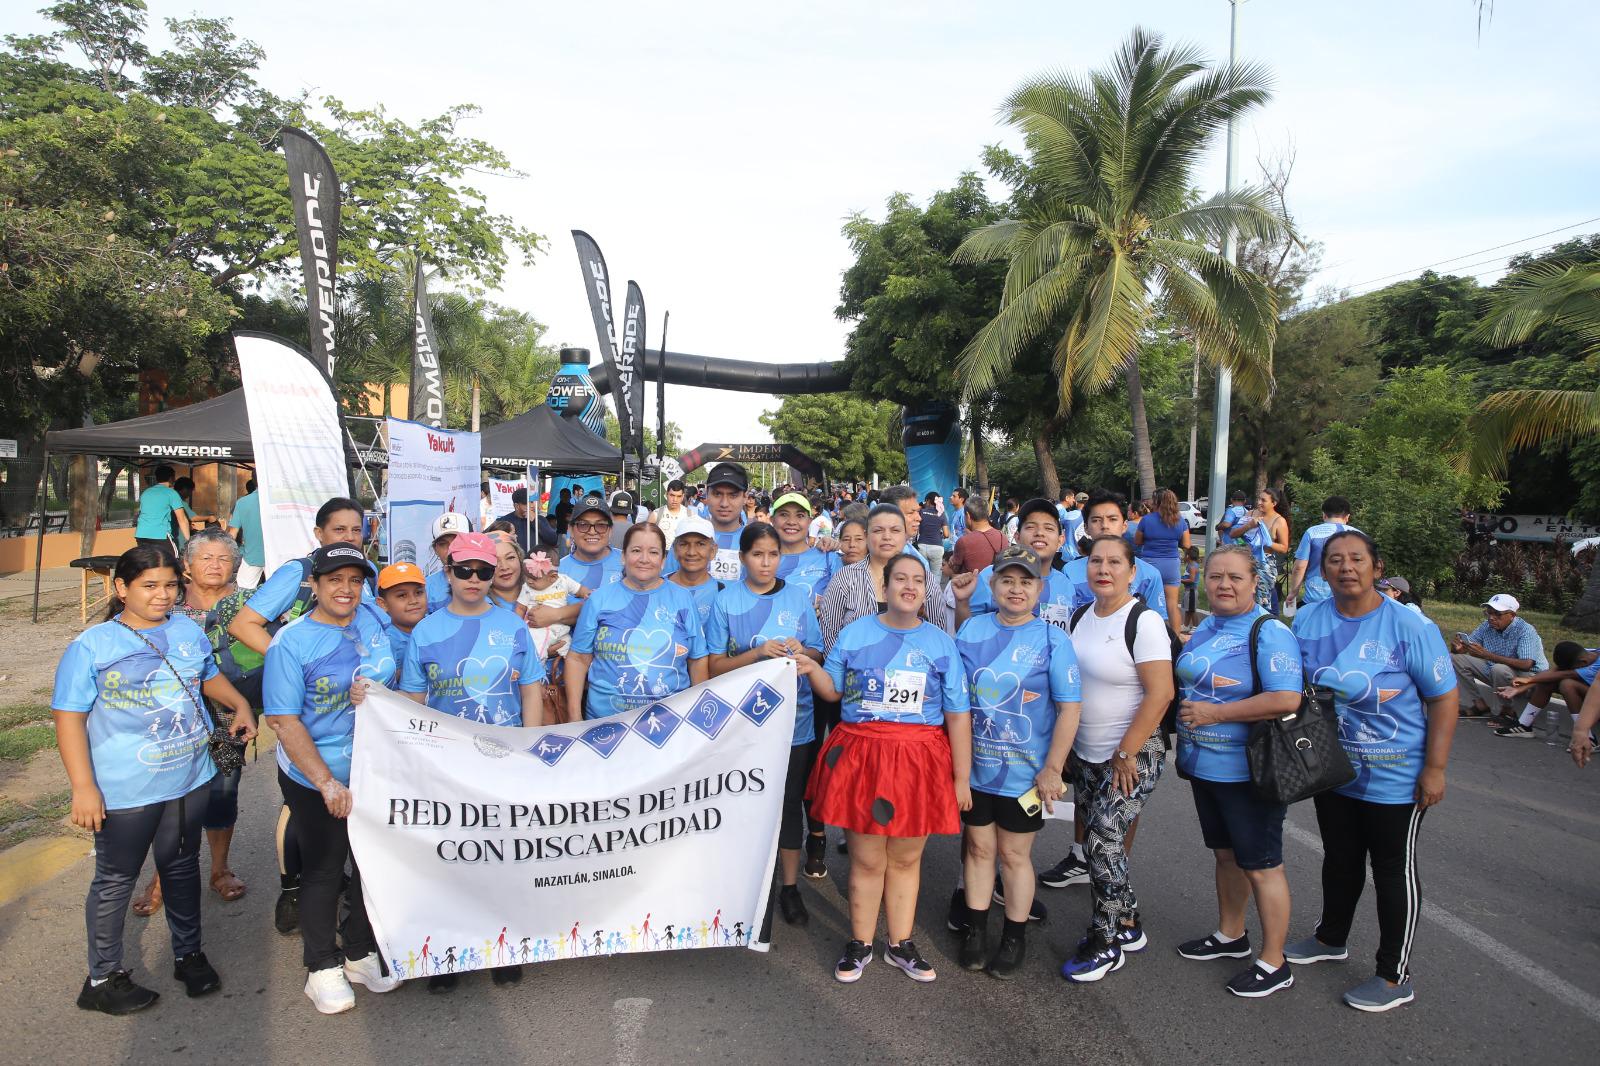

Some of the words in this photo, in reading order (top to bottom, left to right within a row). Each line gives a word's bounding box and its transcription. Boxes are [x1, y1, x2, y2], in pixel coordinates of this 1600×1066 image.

[304, 172, 335, 379] OWERADE
[547, 385, 594, 397] POWER
[427, 432, 455, 453] Yakult
[139, 445, 232, 458] POWERADE
[715, 561, 738, 574] 295
[104, 671, 121, 689] 8
[428, 663, 439, 680] 8
[315, 676, 330, 693] 8
[867, 678, 878, 691] 8
[313, 691, 349, 705] CAMI
[888, 688, 919, 704] 291
[408, 718, 439, 733] SEP
[388, 798, 451, 826] RED
[460, 802, 501, 828] DE
[509, 797, 631, 828] PADRES
[638, 787, 677, 816] DE
[683, 767, 765, 804] HIJOS
[436, 839, 504, 862] CON
[513, 807, 722, 861] DISCAPACIDAD
[534, 871, 591, 888] MAZATLÁN,
[592, 865, 636, 882] SINALOA.
